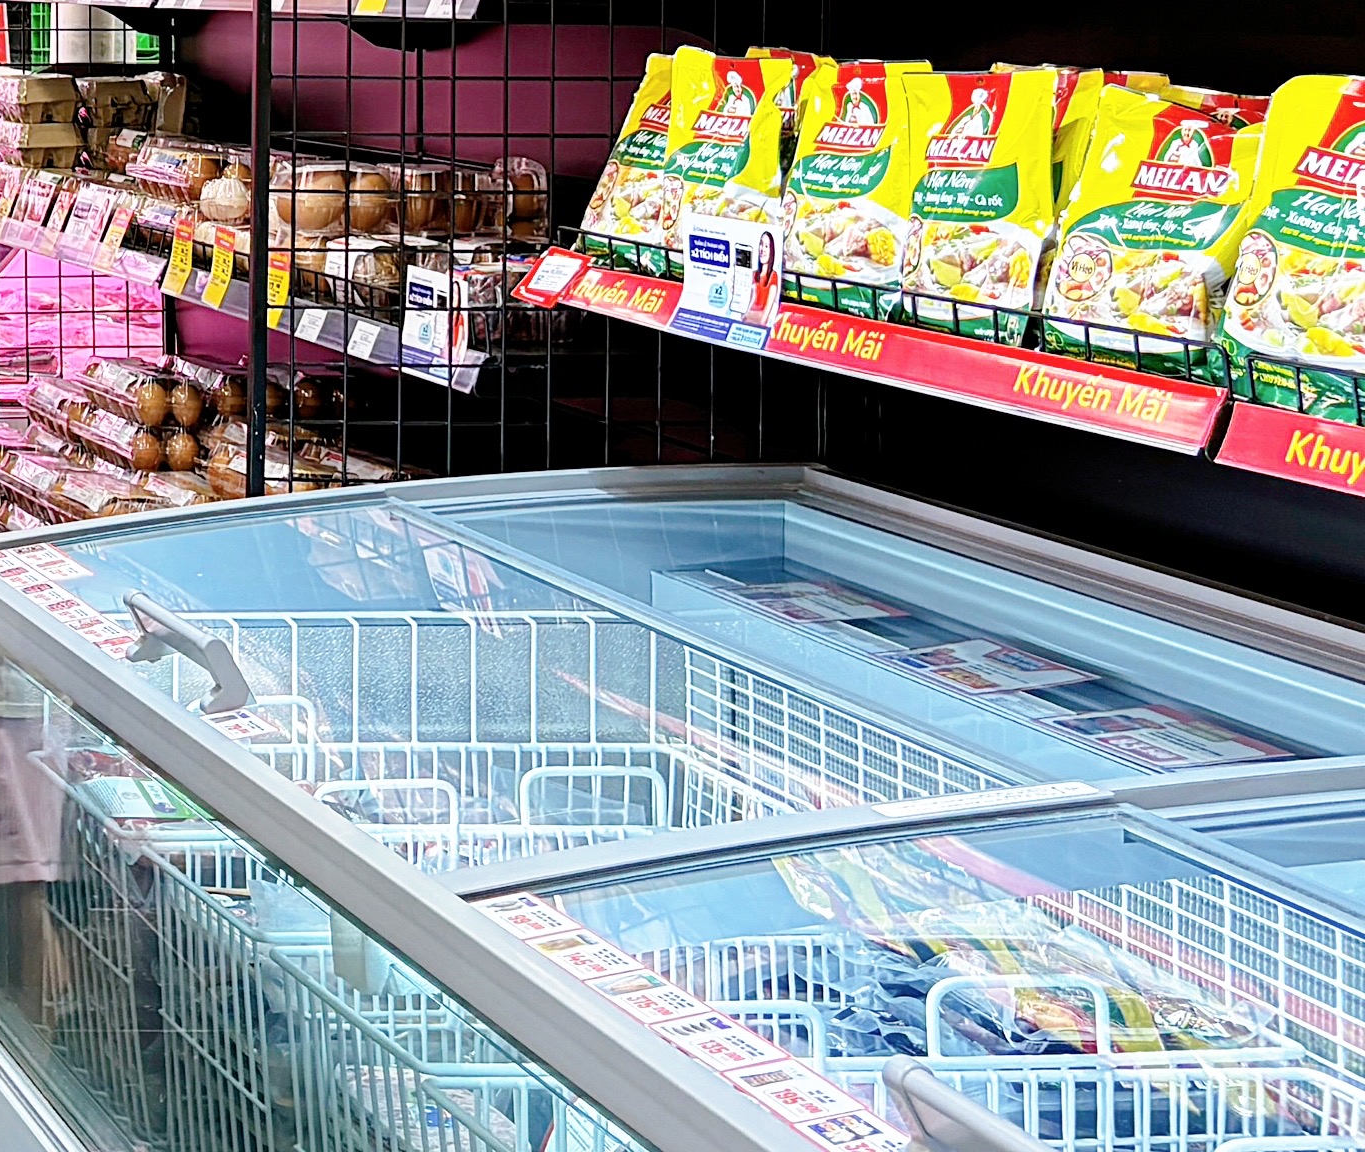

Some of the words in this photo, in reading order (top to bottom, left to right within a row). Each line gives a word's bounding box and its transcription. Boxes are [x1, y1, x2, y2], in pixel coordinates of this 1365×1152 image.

[819, 126, 883, 146] MEIZAN
[927, 139, 994, 159] MEIZAN
[1134, 165, 1228, 194] MEIZAN
[573, 277, 628, 308] huyến
[628, 287, 665, 314] Mãi
[842, 329, 885, 361] Mãi
[1013, 364, 1112, 412] Khuyến
[1117, 384, 1172, 424] Mãi
[1286, 429, 1365, 485] Khuy
